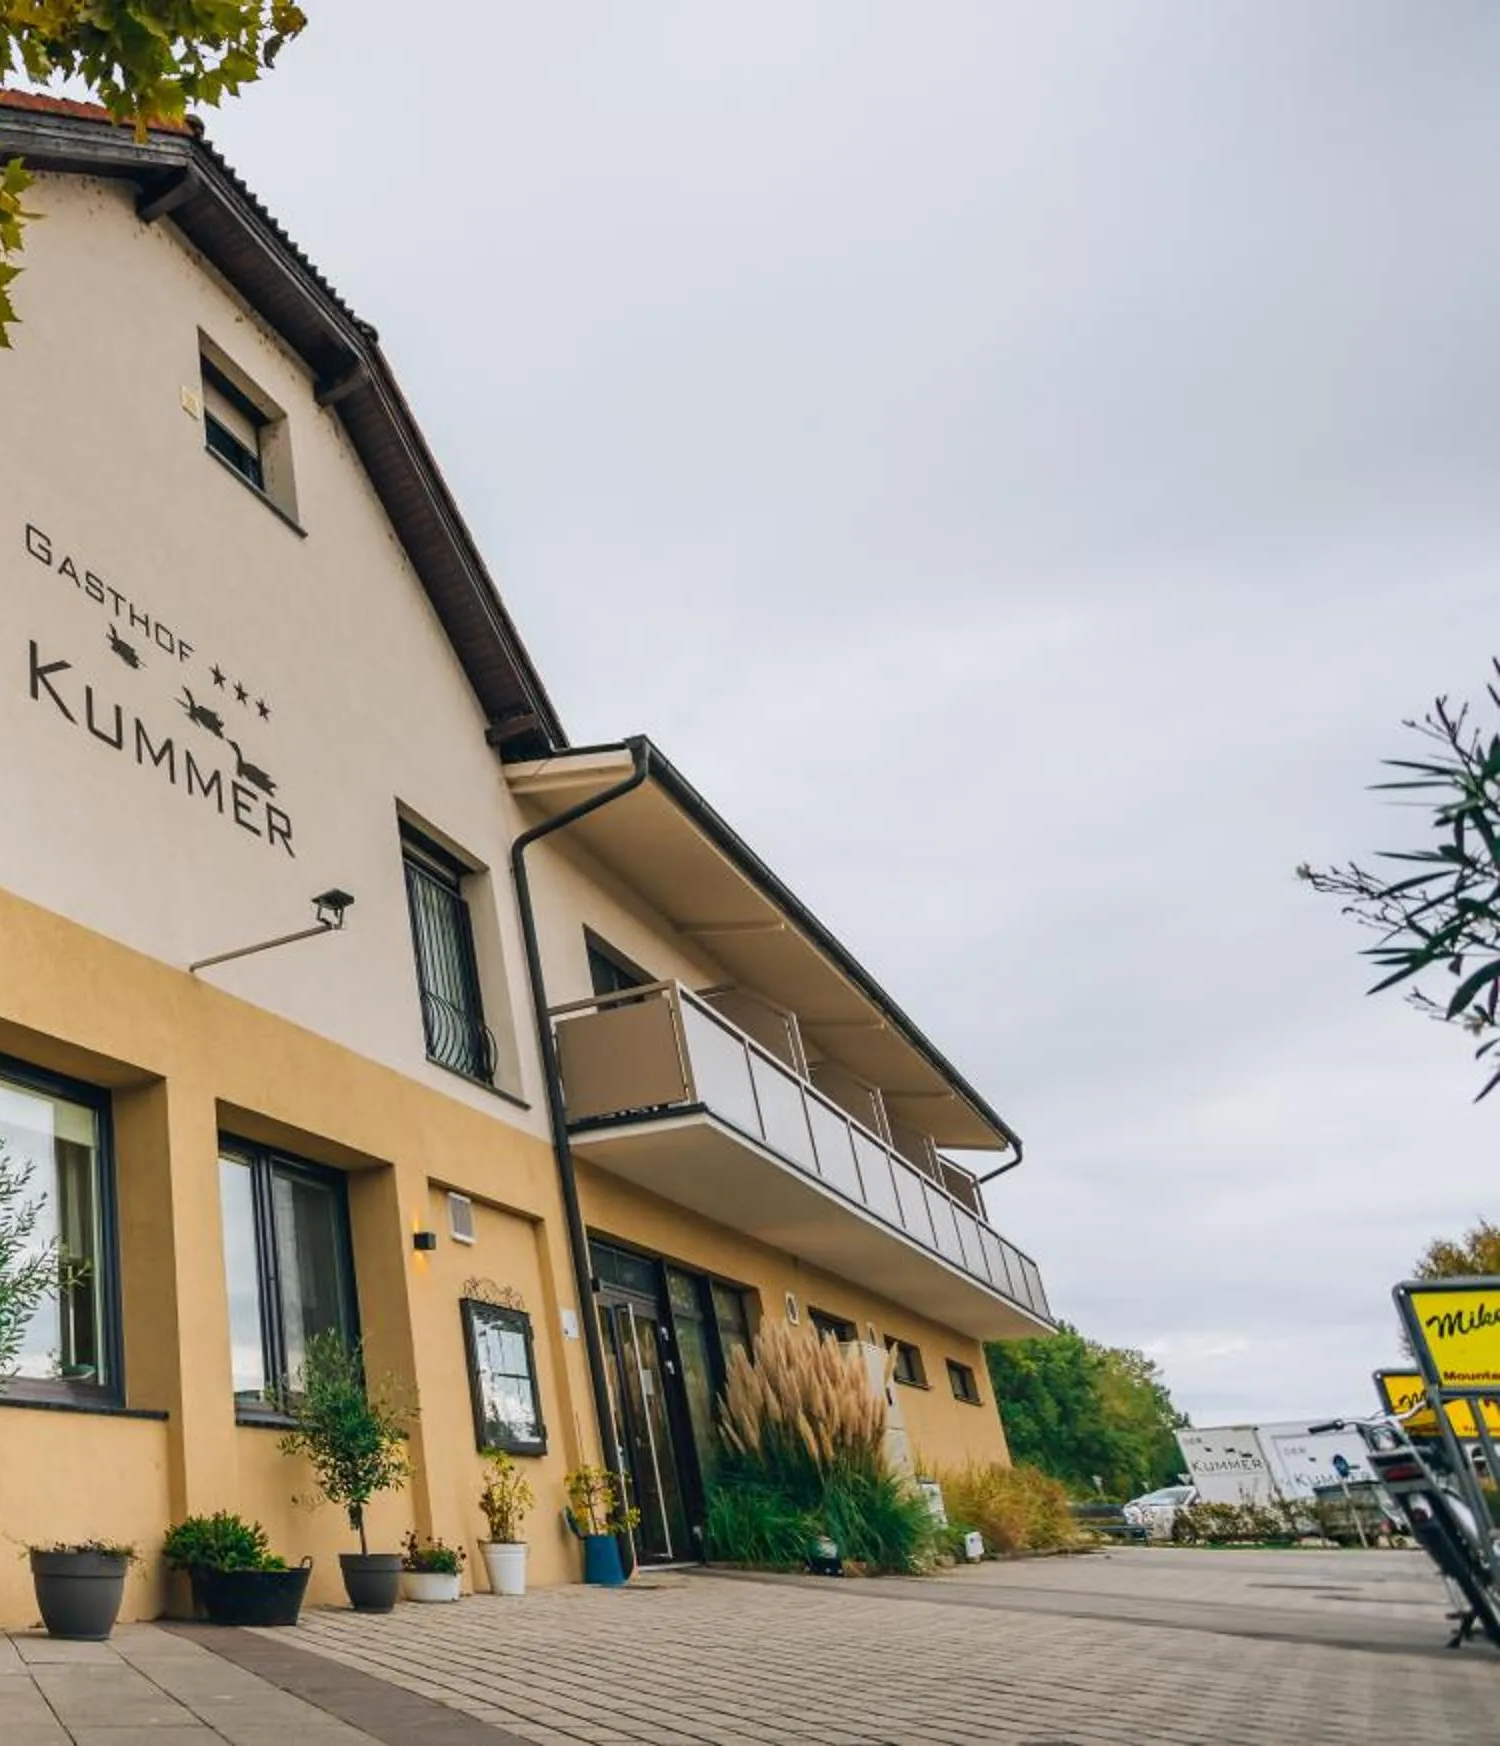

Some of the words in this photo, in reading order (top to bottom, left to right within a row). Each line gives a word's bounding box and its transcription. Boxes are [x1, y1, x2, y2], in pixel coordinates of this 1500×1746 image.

[25, 523, 195, 662] GASTHOF
[29, 639, 296, 859] KUMMER
[1192, 1459, 1264, 1472] KUMMER
